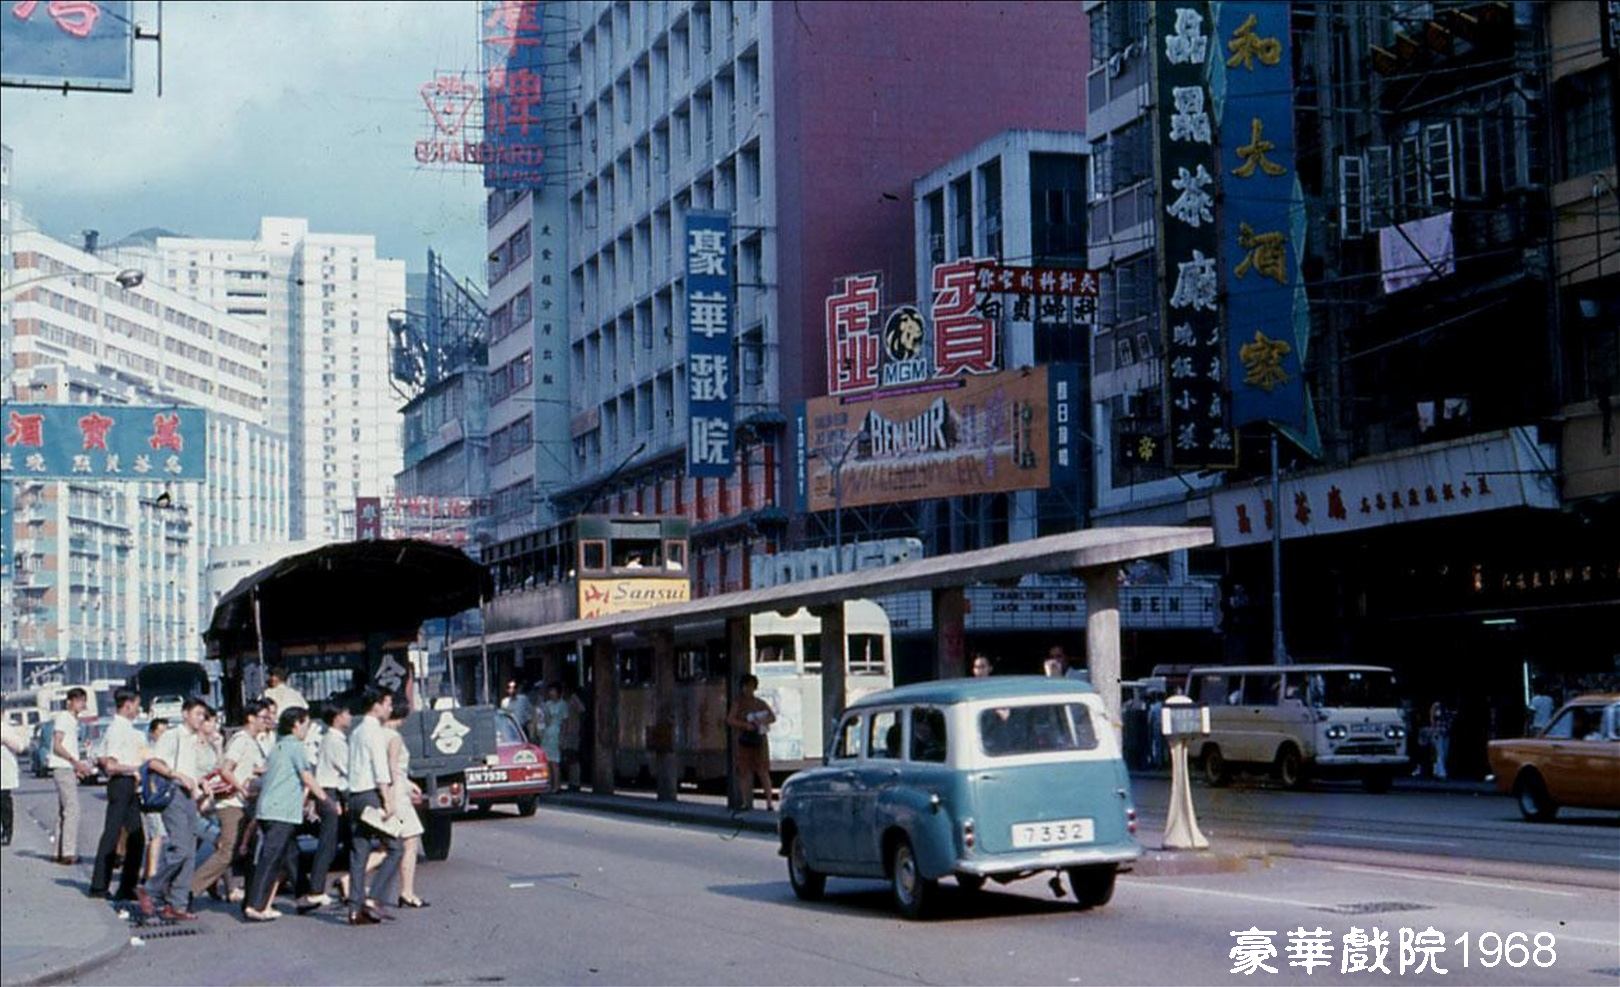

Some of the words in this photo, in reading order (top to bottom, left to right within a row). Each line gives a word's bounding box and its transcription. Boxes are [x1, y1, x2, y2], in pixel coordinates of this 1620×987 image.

[883, 359, 926, 386] MGM
[613, 581, 687, 602] Sansui
[1131, 596, 1180, 613] BEN
[1022, 822, 1084, 843] 7332
